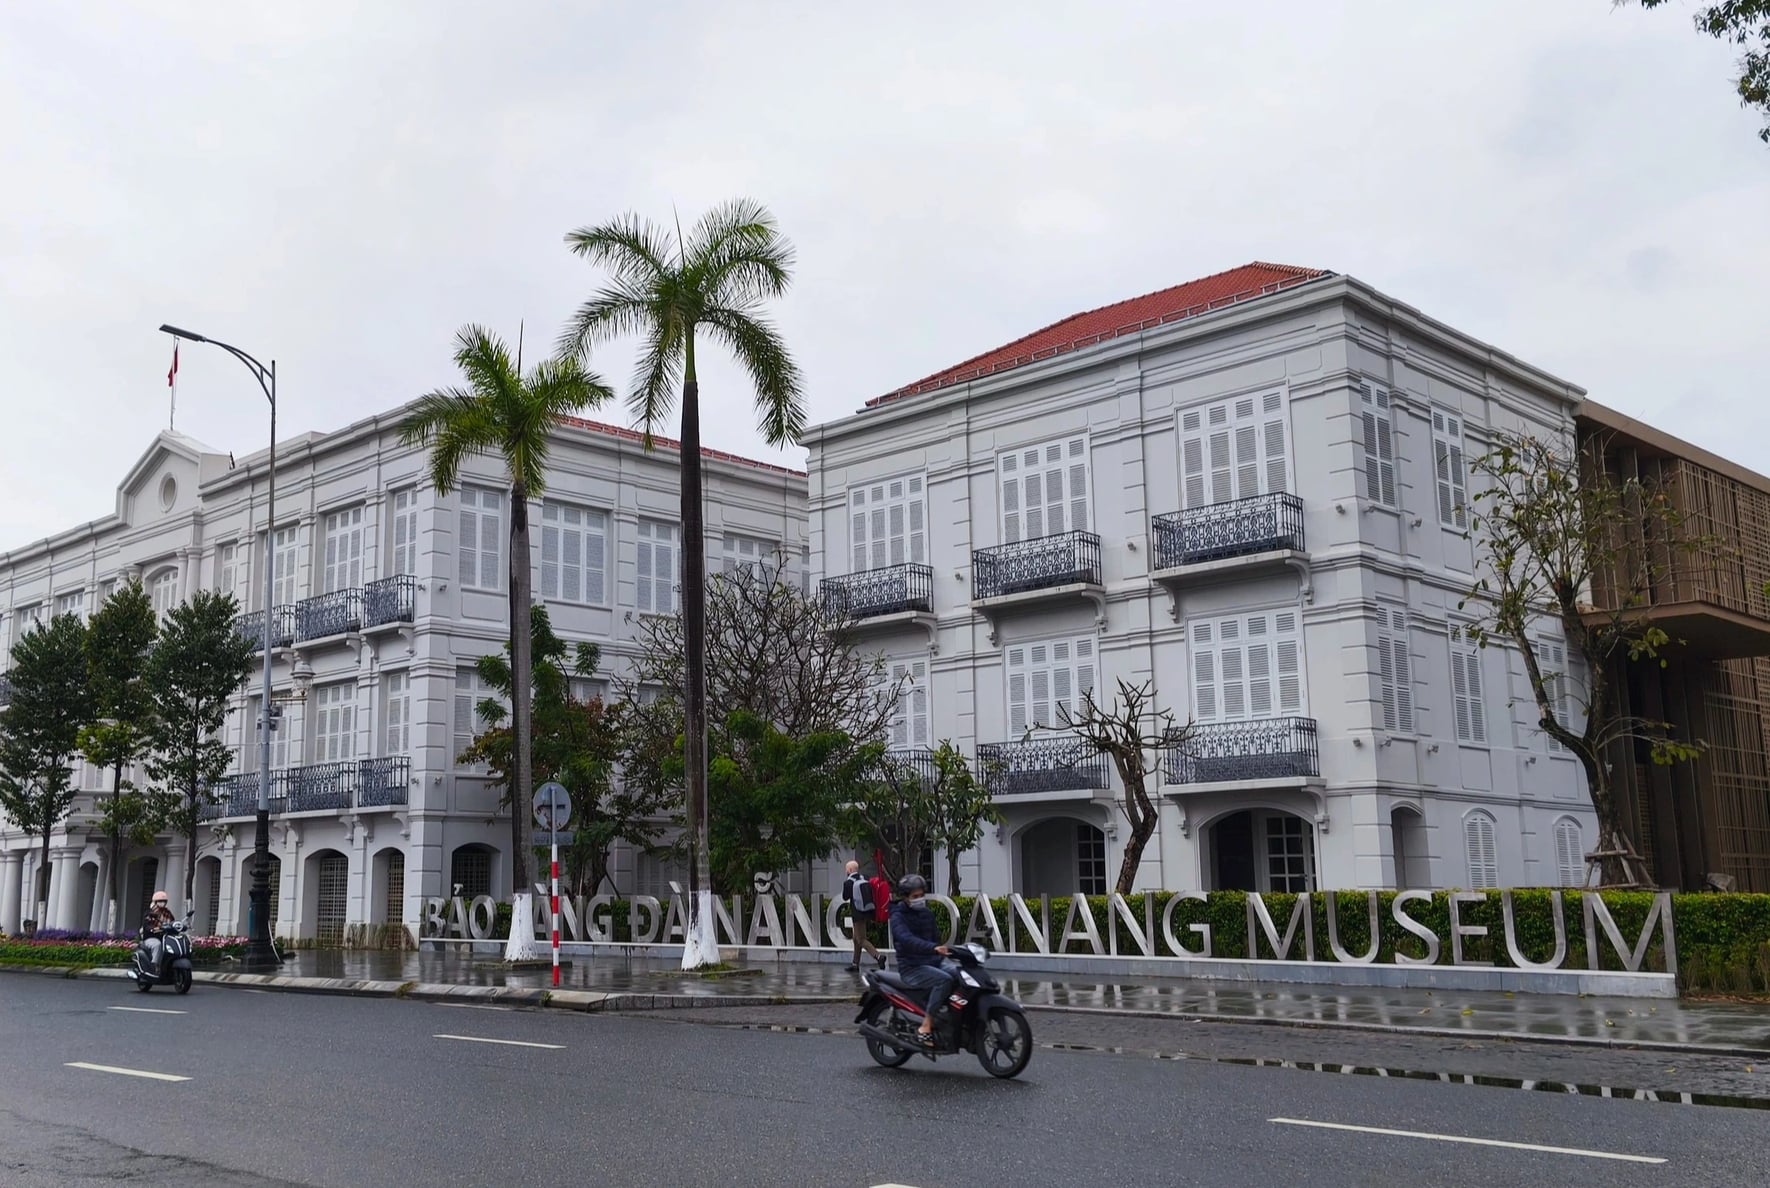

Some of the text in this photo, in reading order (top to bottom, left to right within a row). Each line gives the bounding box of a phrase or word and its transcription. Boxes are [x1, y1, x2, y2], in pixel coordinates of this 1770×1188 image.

[420, 883, 498, 939] BẢO
[512, 882, 615, 942] ÀNG
[627, 881, 691, 944] ĐÀ
[1246, 890, 1677, 971] MUSEUM
